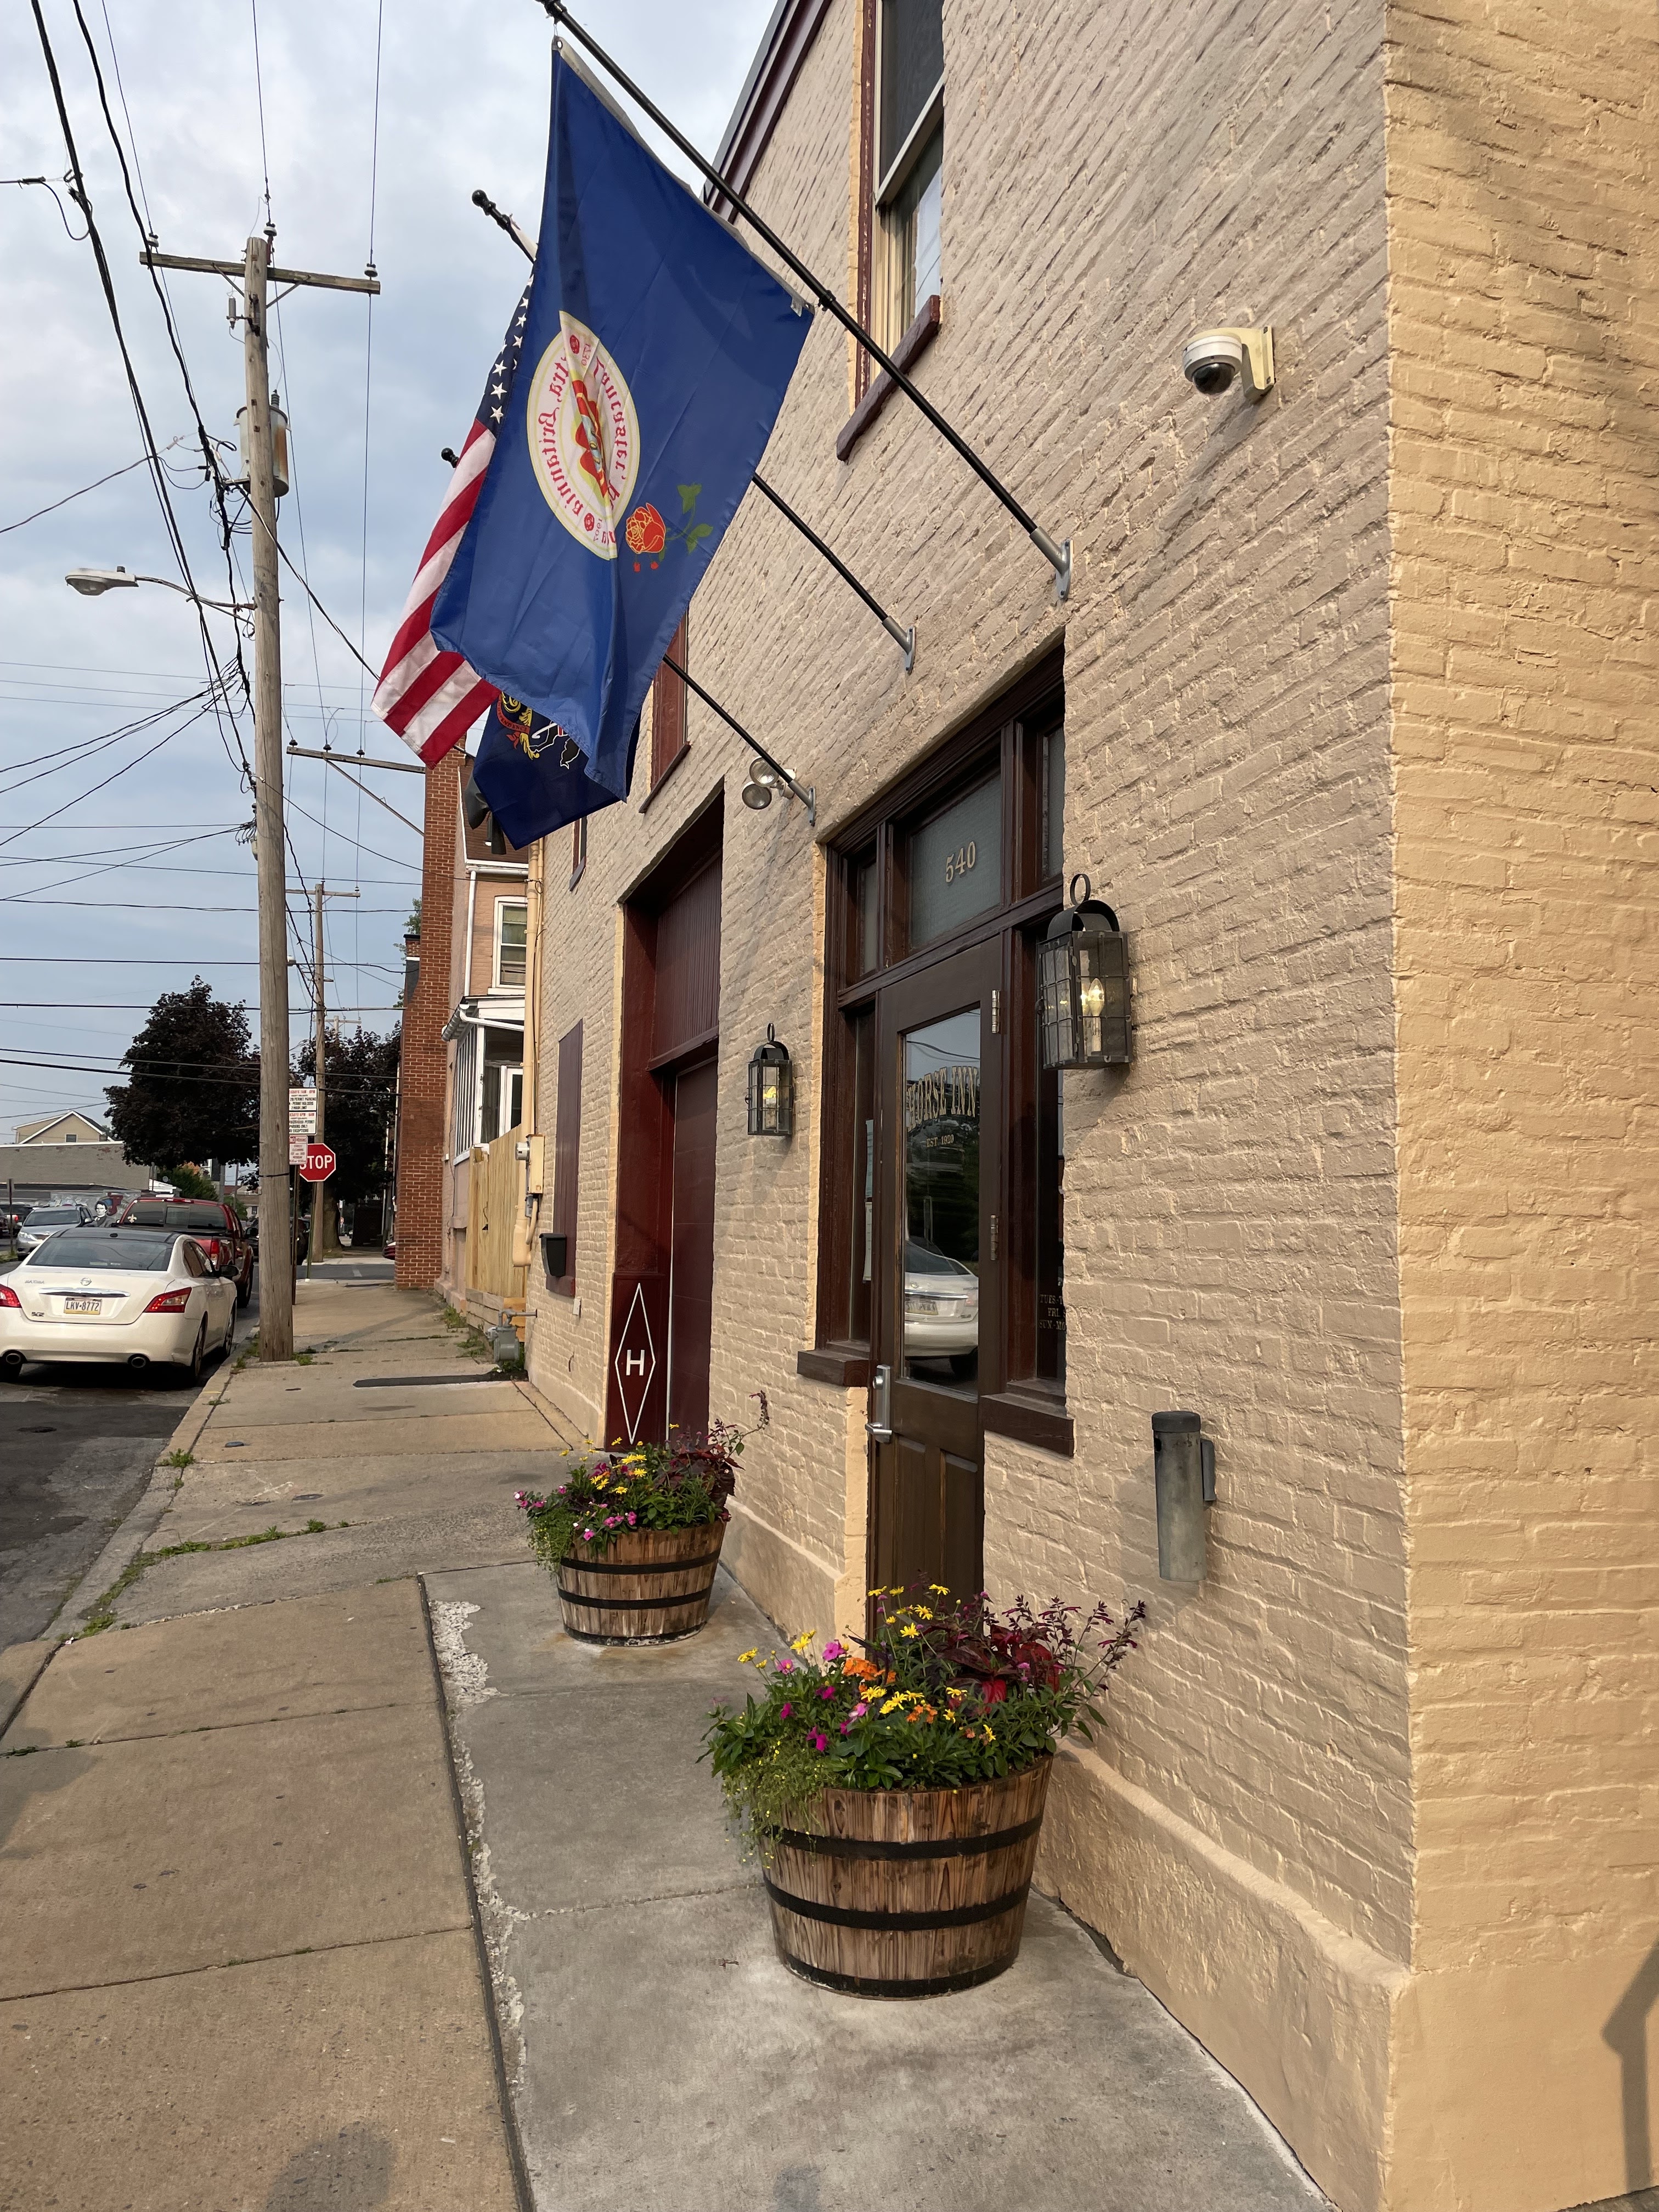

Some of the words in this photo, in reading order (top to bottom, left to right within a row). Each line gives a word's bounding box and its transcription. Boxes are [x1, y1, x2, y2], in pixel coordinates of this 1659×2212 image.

[944, 840, 977, 884] 540
[951, 1065, 978, 1118] INN
[625, 1349, 645, 1376] H
